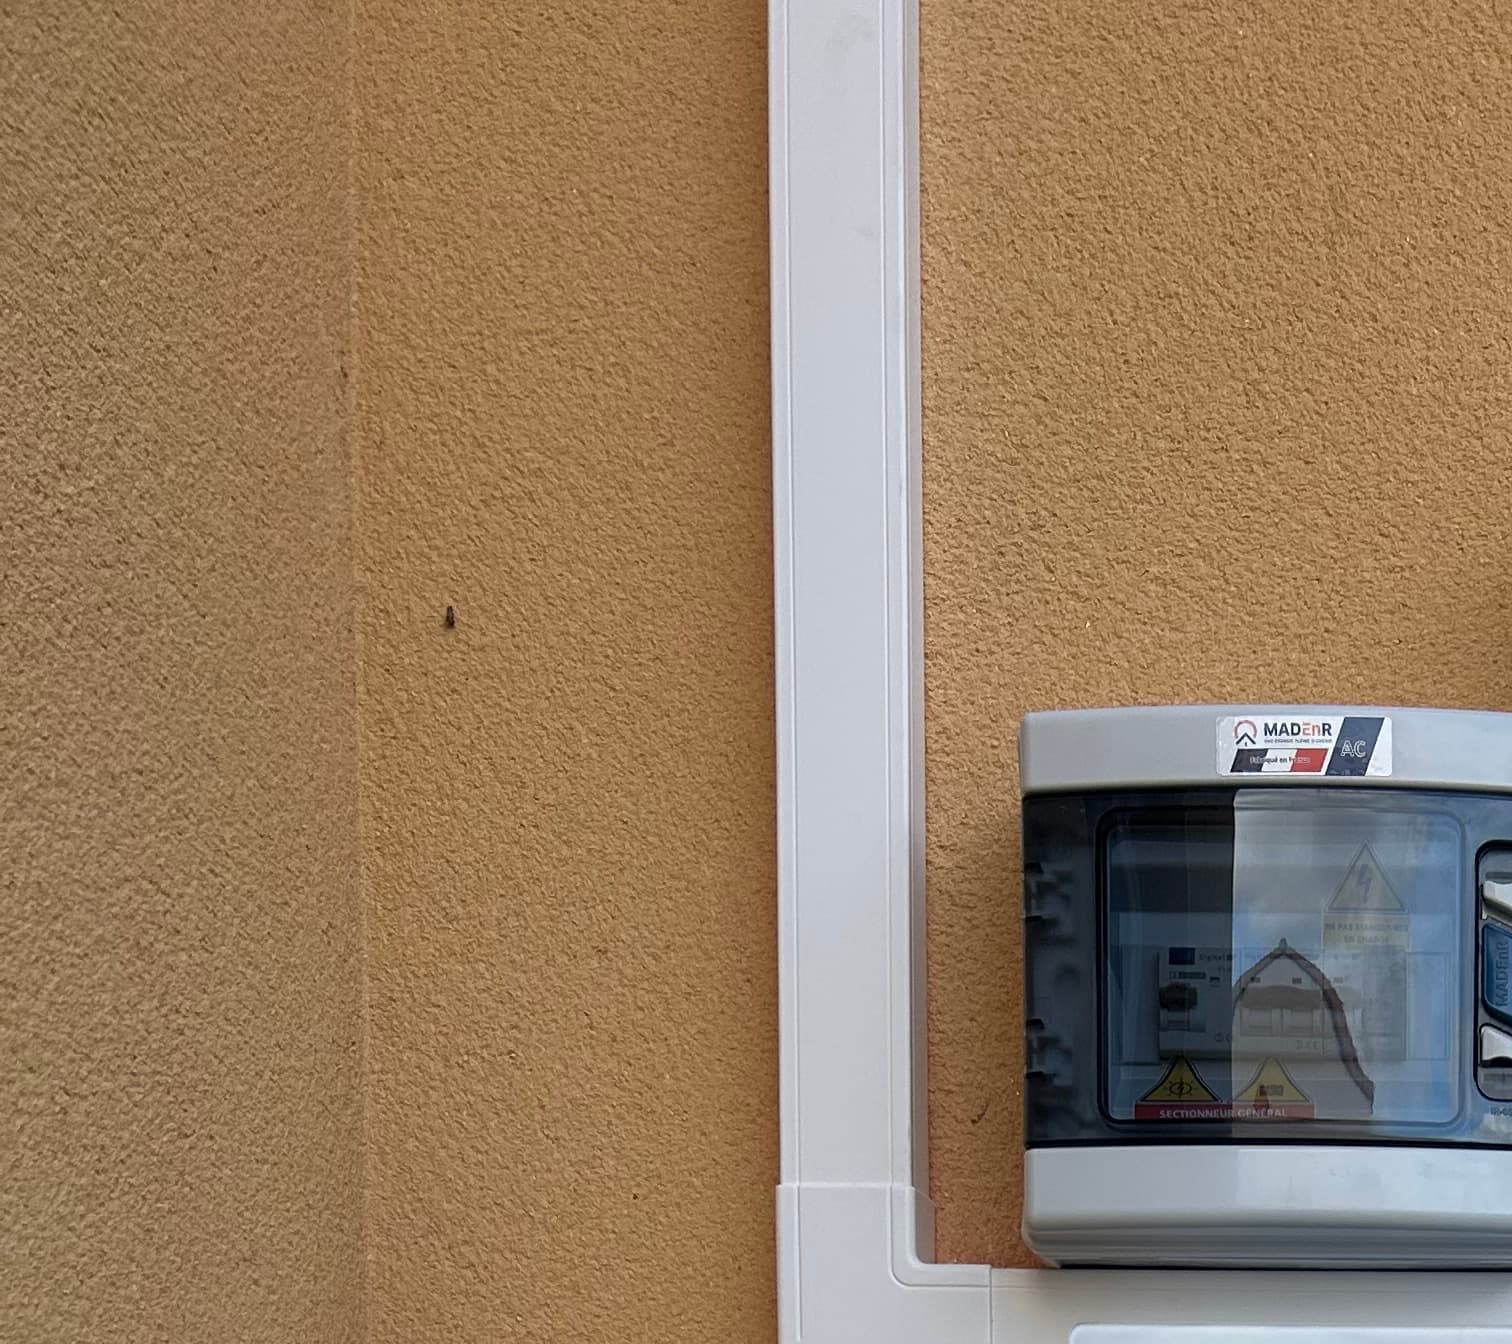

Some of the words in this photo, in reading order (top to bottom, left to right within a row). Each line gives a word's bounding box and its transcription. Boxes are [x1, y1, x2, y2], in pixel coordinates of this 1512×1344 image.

[1263, 722, 1332, 737] MADEnR
[1340, 740, 1366, 758] AC
[1159, 1108, 1233, 1119] SECTIONNEUR
